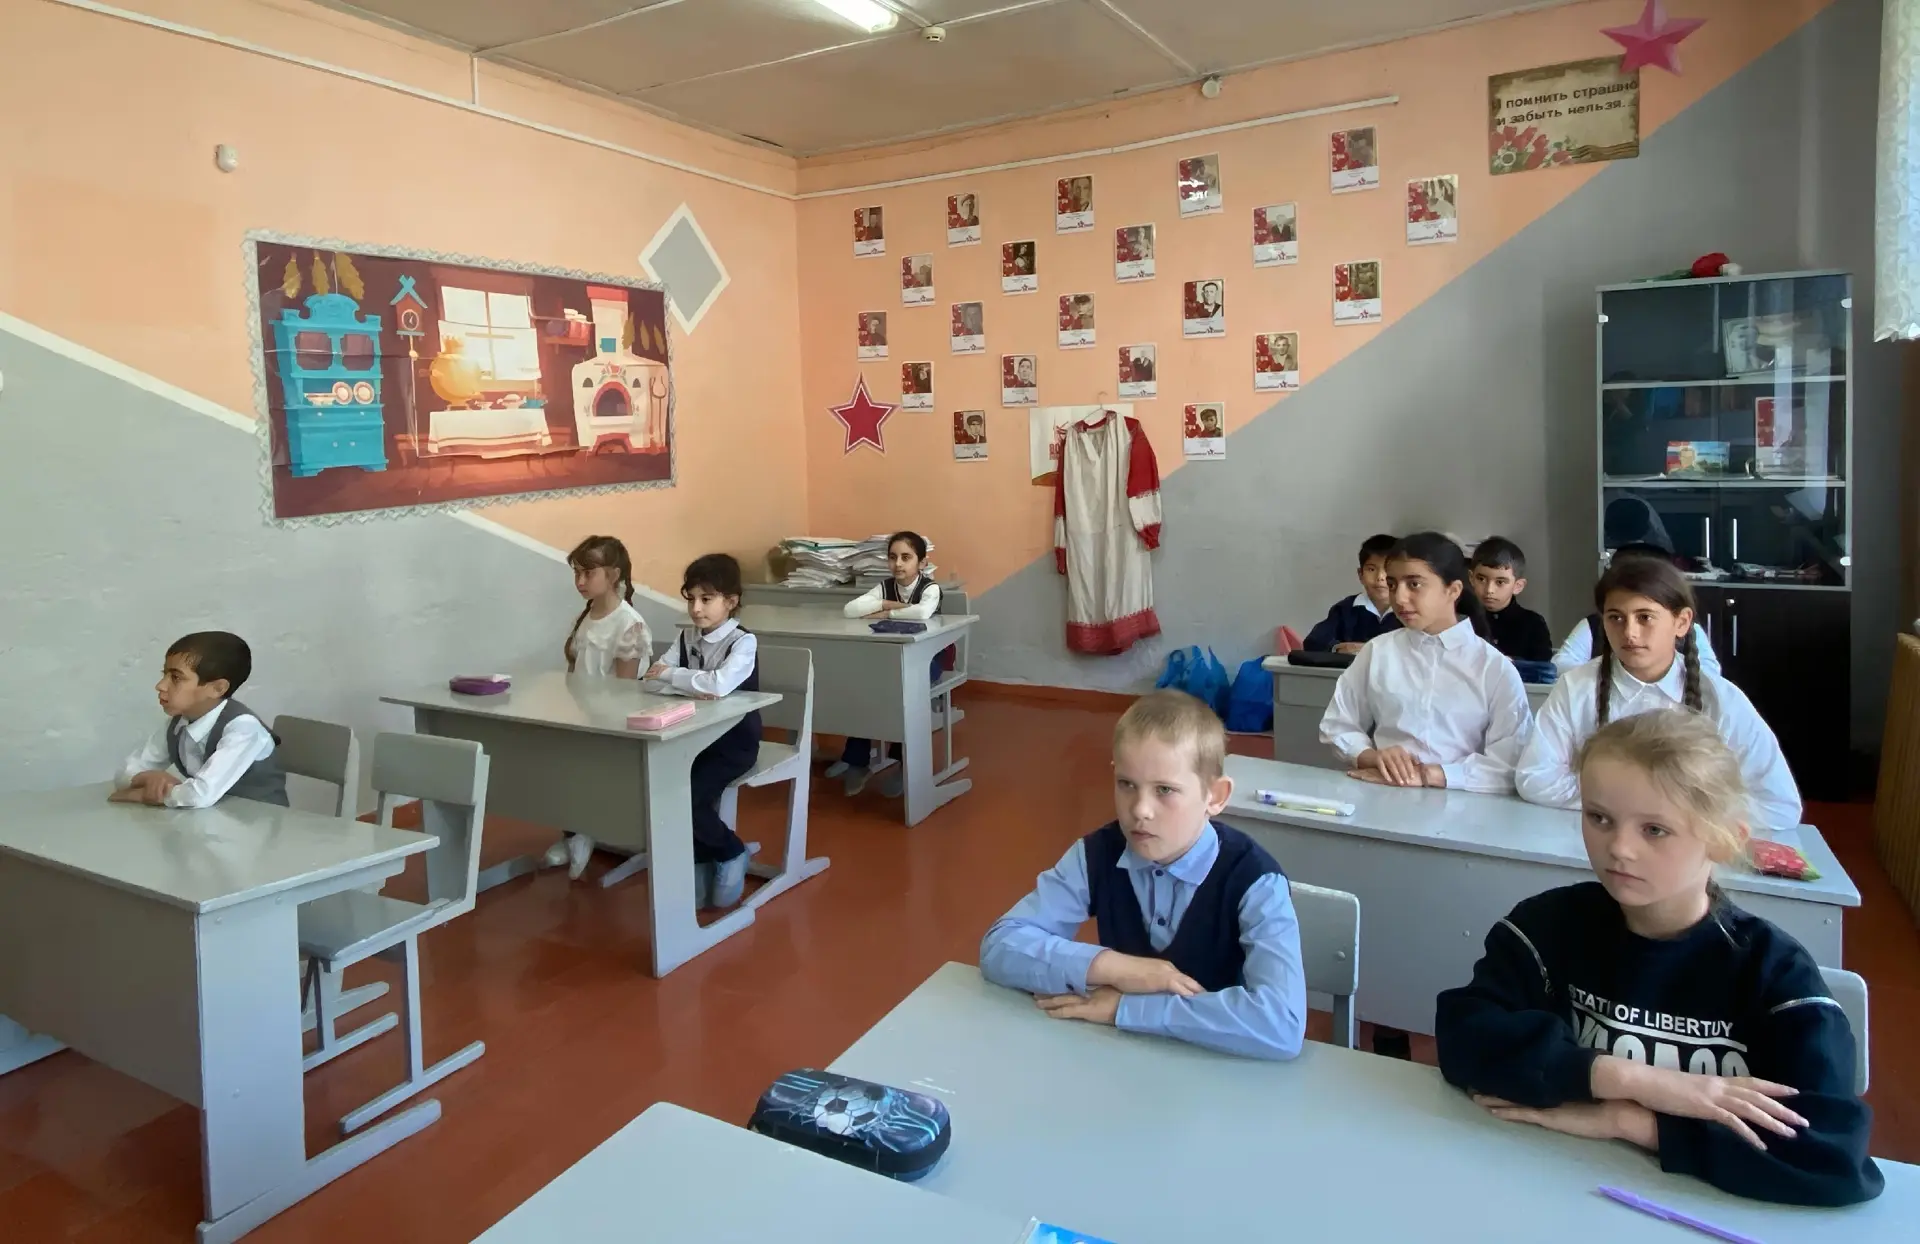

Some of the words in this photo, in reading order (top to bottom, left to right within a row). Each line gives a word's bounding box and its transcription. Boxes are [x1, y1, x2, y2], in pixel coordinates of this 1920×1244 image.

[1506, 92, 1568, 108] помнить
[1509, 109, 1563, 124] забыть
[1614, 1003, 1641, 1023] OF
